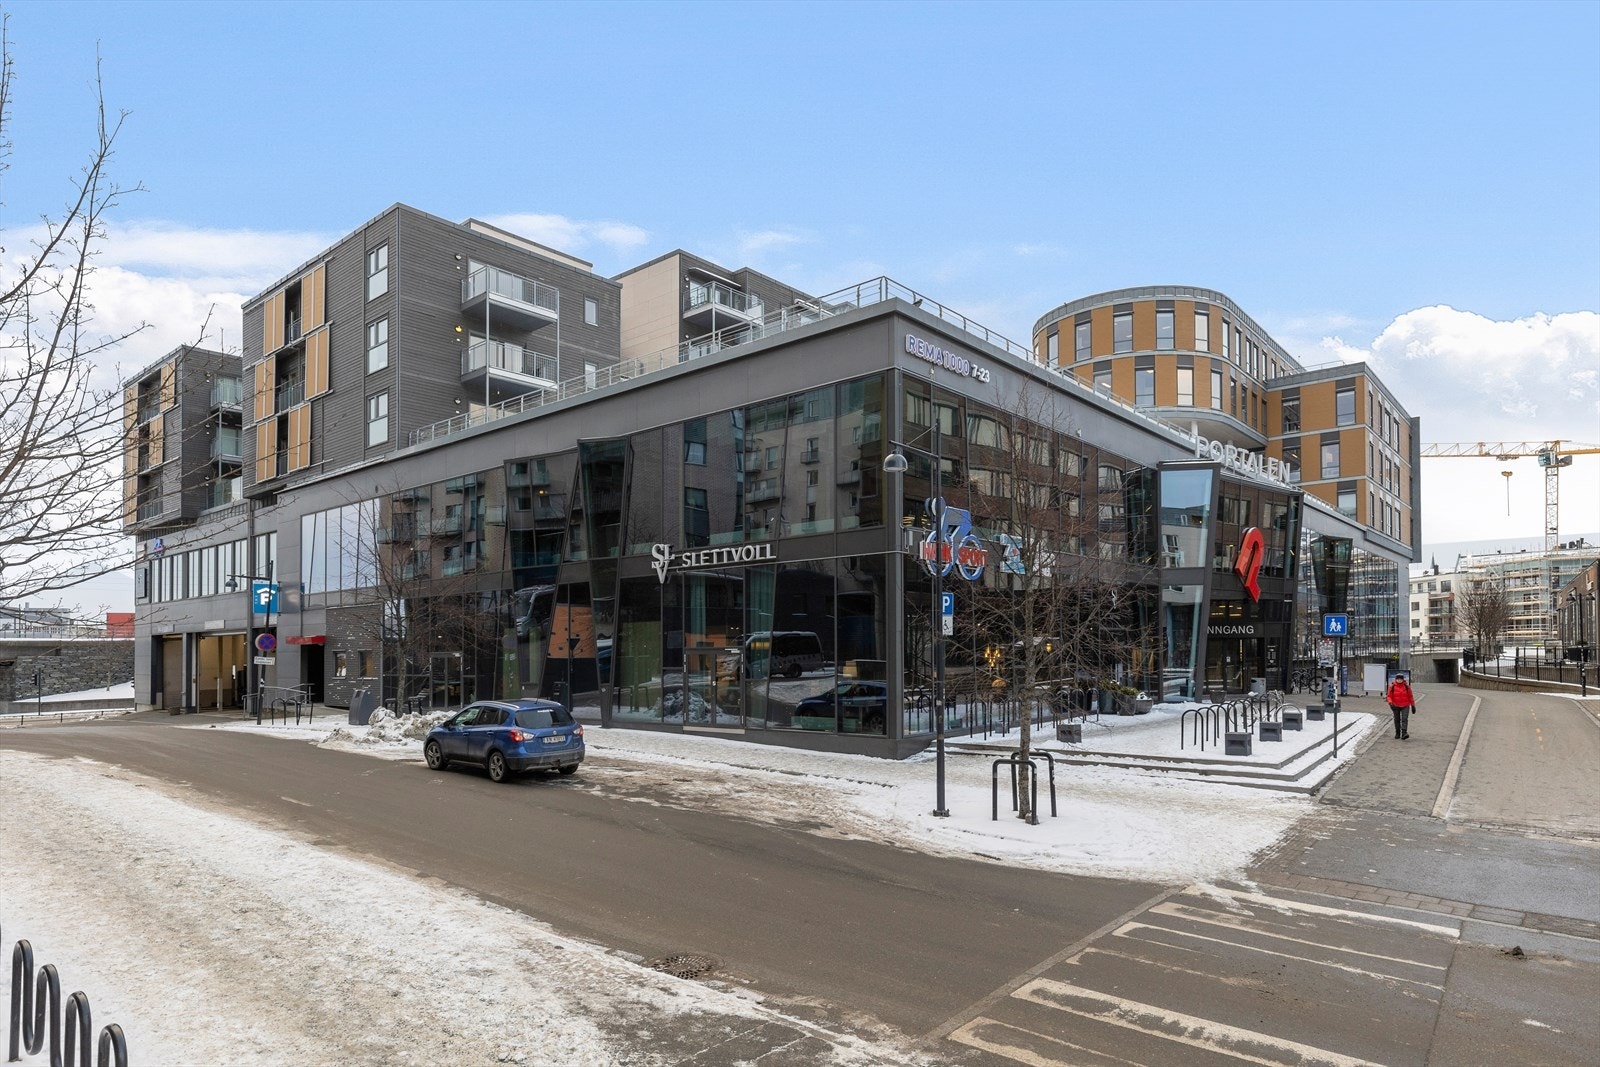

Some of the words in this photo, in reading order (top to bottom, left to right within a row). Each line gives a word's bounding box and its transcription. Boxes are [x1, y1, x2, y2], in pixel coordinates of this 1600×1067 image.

[906, 334, 943, 366] REMA
[943, 350, 970, 377] 1000
[971, 363, 990, 383] 7-23
[1195, 435, 1290, 484] PORTALEN
[682, 543, 776, 568] SLETTVOLL
[959, 548, 988, 567] SPORT
[943, 596, 950, 613] P
[1206, 625, 1255, 634] NNGANG
